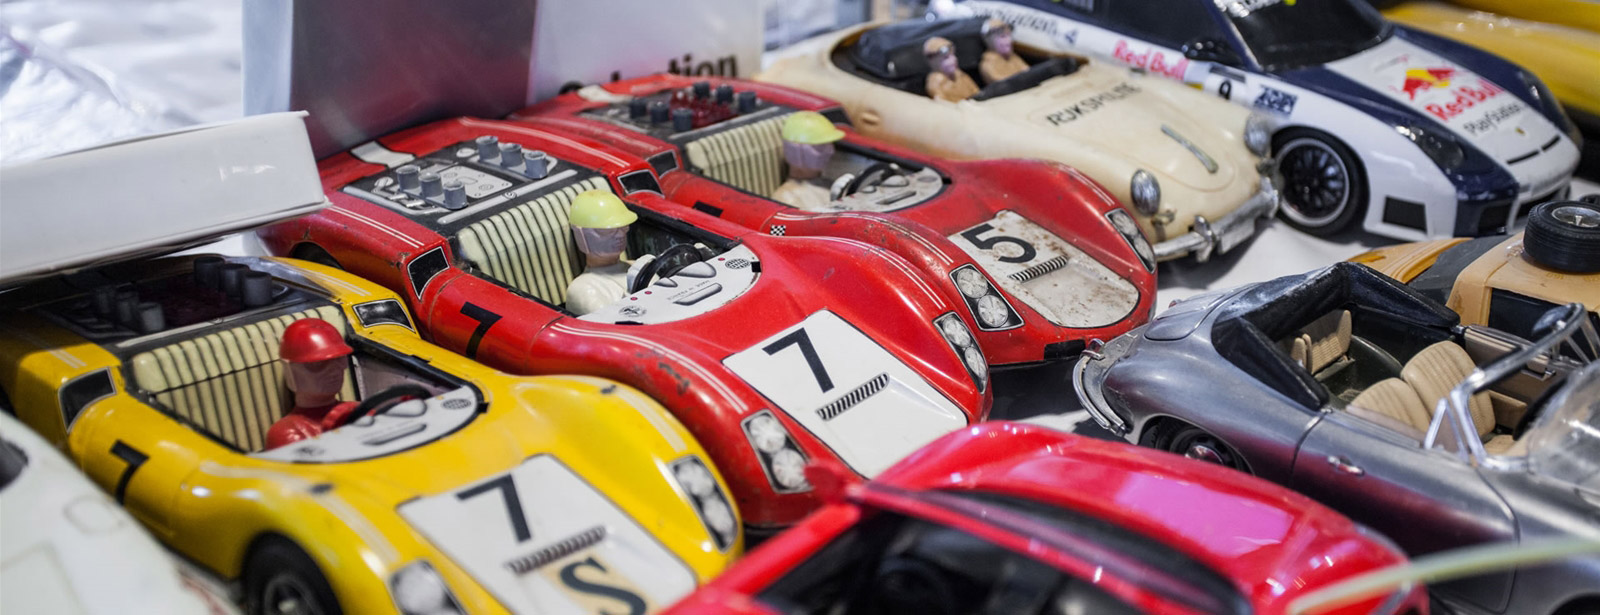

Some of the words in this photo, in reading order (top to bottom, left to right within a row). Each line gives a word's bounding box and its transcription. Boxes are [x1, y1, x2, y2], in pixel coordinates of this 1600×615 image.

[1113, 40, 1151, 69] Red
[1150, 52, 1189, 81] Bull
[1425, 90, 1474, 123] Red
[1459, 77, 1505, 105] Bull
[960, 223, 1037, 264] 5
[460, 301, 503, 360] 7
[763, 327, 835, 393] 7
[109, 440, 151, 507] 7
[455, 473, 532, 543] 7
[559, 556, 647, 615] S
